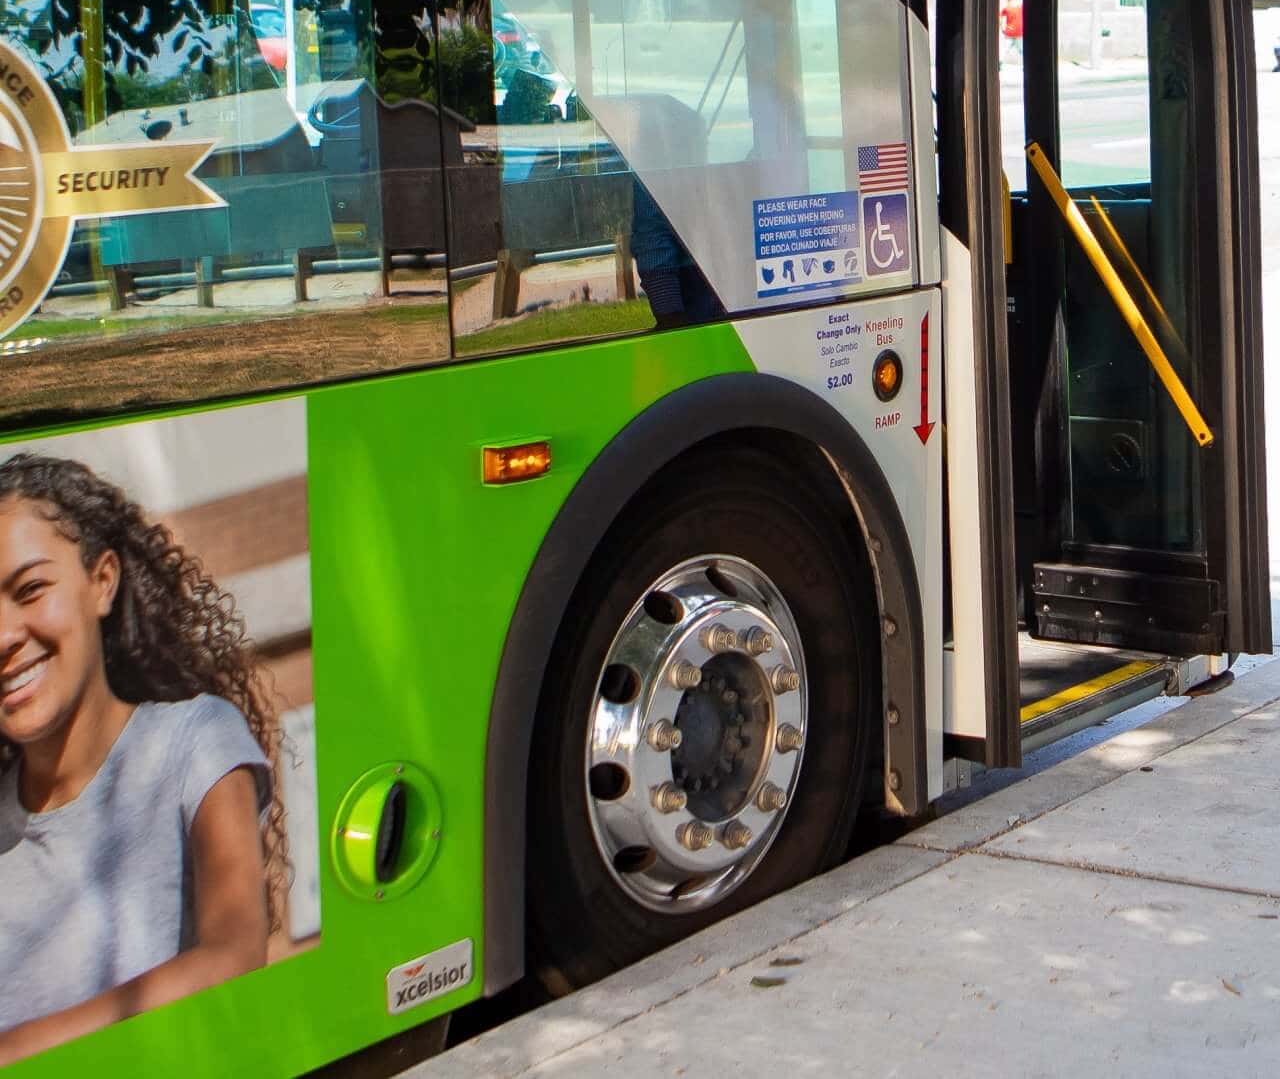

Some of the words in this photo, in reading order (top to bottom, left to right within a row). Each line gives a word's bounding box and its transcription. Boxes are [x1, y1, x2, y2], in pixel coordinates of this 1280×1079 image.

[57, 167, 170, 194] SECURITY
[758, 201, 785, 214] PLEASE
[786, 200, 808, 211] WEAR
[809, 198, 827, 208] FACE
[759, 215, 796, 227] COVERING
[797, 213, 818, 222] WHEN
[820, 210, 844, 220] RIDING
[760, 233, 774, 242] POR
[800, 228, 813, 237] USE
[814, 224, 856, 235] COBERTURAS
[760, 246, 770, 255] DE
[771, 244, 790, 253] BOCA
[820, 238, 838, 248] VIAJE
[828, 313, 849, 324] Exact
[865, 316, 904, 333] Kneeling
[816, 328, 843, 340] Change
[845, 325, 861, 335] Only
[876, 334, 893, 345] Bus
[820, 346, 834, 356] Solo
[836, 342, 858, 353] Cambio
[827, 373, 853, 390] $2.00
[875, 413, 901, 429] RAMP
[396, 962, 467, 1007] xcelsior
